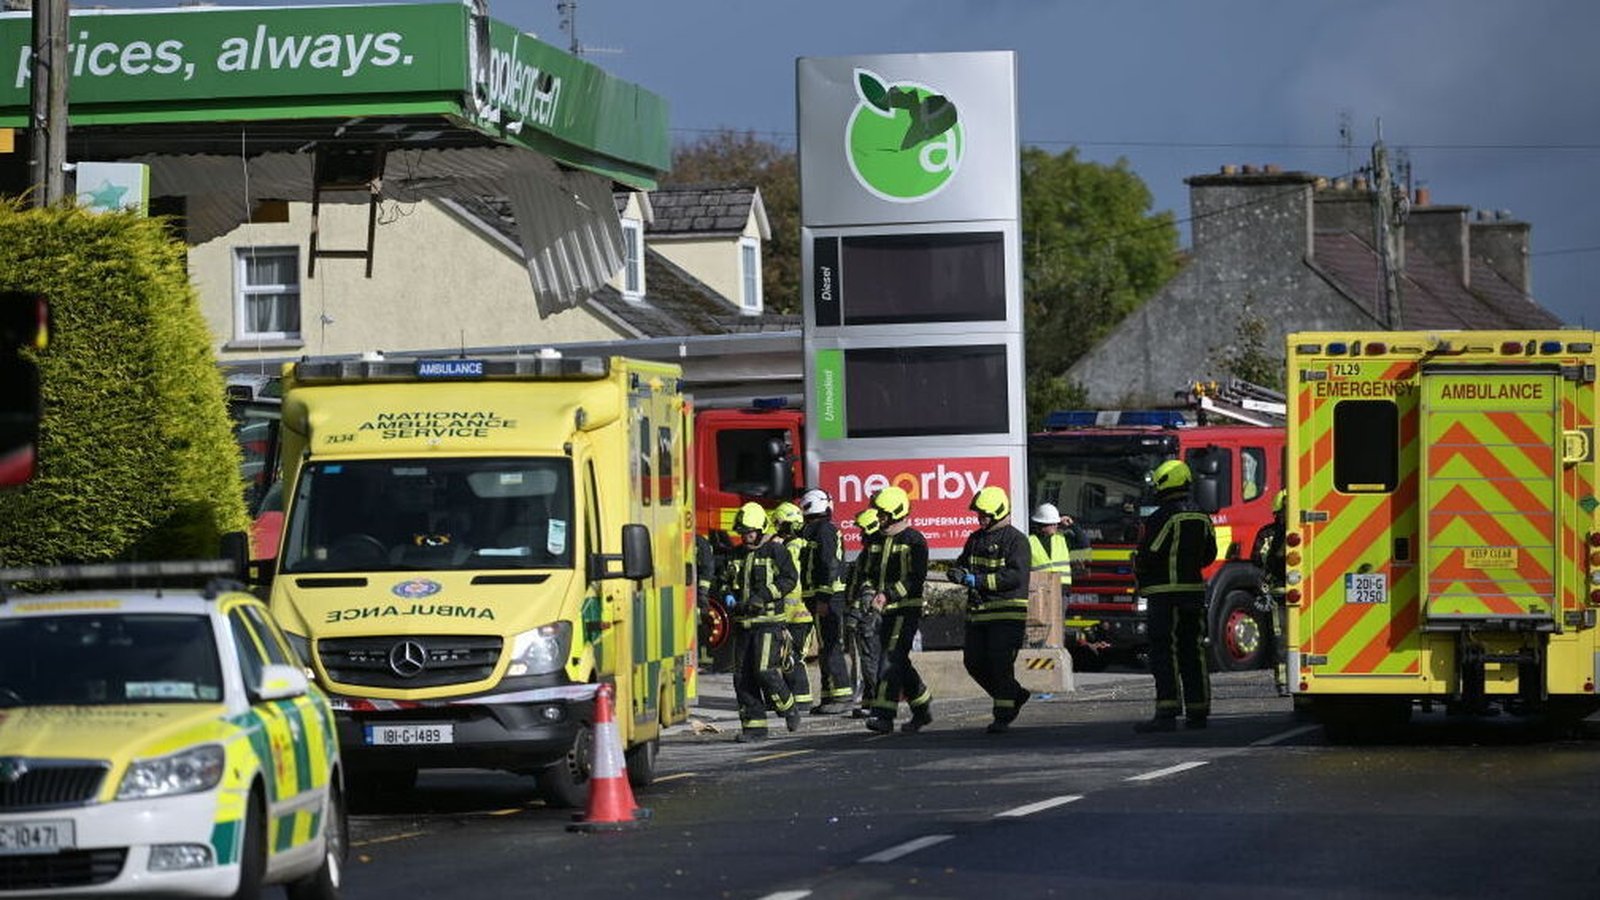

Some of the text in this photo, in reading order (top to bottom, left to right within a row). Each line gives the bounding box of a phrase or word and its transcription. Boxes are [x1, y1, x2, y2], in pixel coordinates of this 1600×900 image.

[15, 24, 414, 88] pices, always.
[488, 35, 562, 128] pplegreen
[820, 265, 832, 301] Diesel
[419, 362, 484, 376] AMBULANCE
[1334, 363, 1360, 376] 7L29
[824, 368, 835, 422] Unleaded
[1316, 381, 1543, 400] EMERGENCY AMBULANCE
[377, 411, 502, 422] NATIONAL
[359, 420, 518, 432] AMBULANCE
[382, 428, 489, 440] SERVICE
[838, 464, 990, 503] nearby
[914, 516, 980, 527] SUPERMARK
[1356, 578, 1384, 590] 201-G
[383, 729, 442, 744] 181-G-1489
